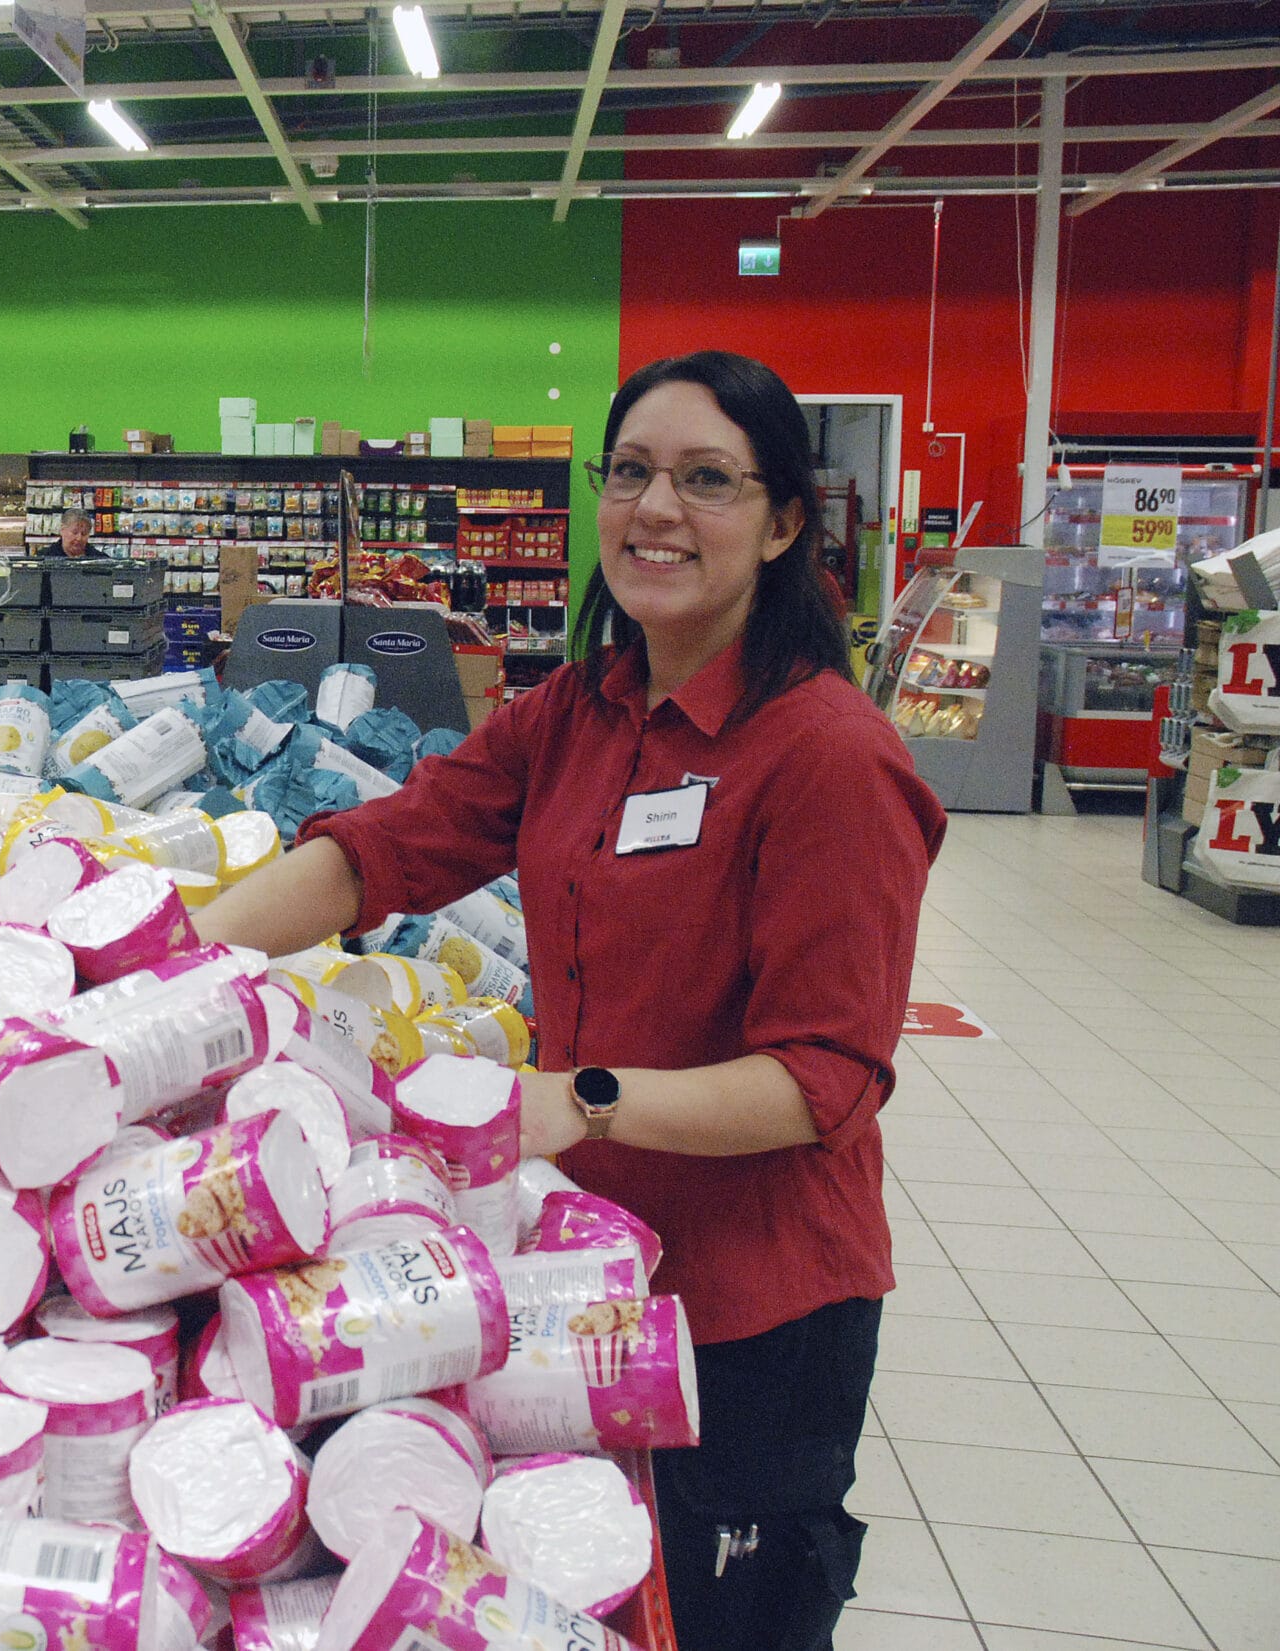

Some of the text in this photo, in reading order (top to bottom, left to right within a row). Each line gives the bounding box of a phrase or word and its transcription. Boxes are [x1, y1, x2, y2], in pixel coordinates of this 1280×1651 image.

[262, 634, 310, 643] Santa Maria
[372, 638, 421, 647] Santa Maria
[85, 1205, 106, 1259] FRIGGS
[104, 1179, 146, 1272] MAJS
